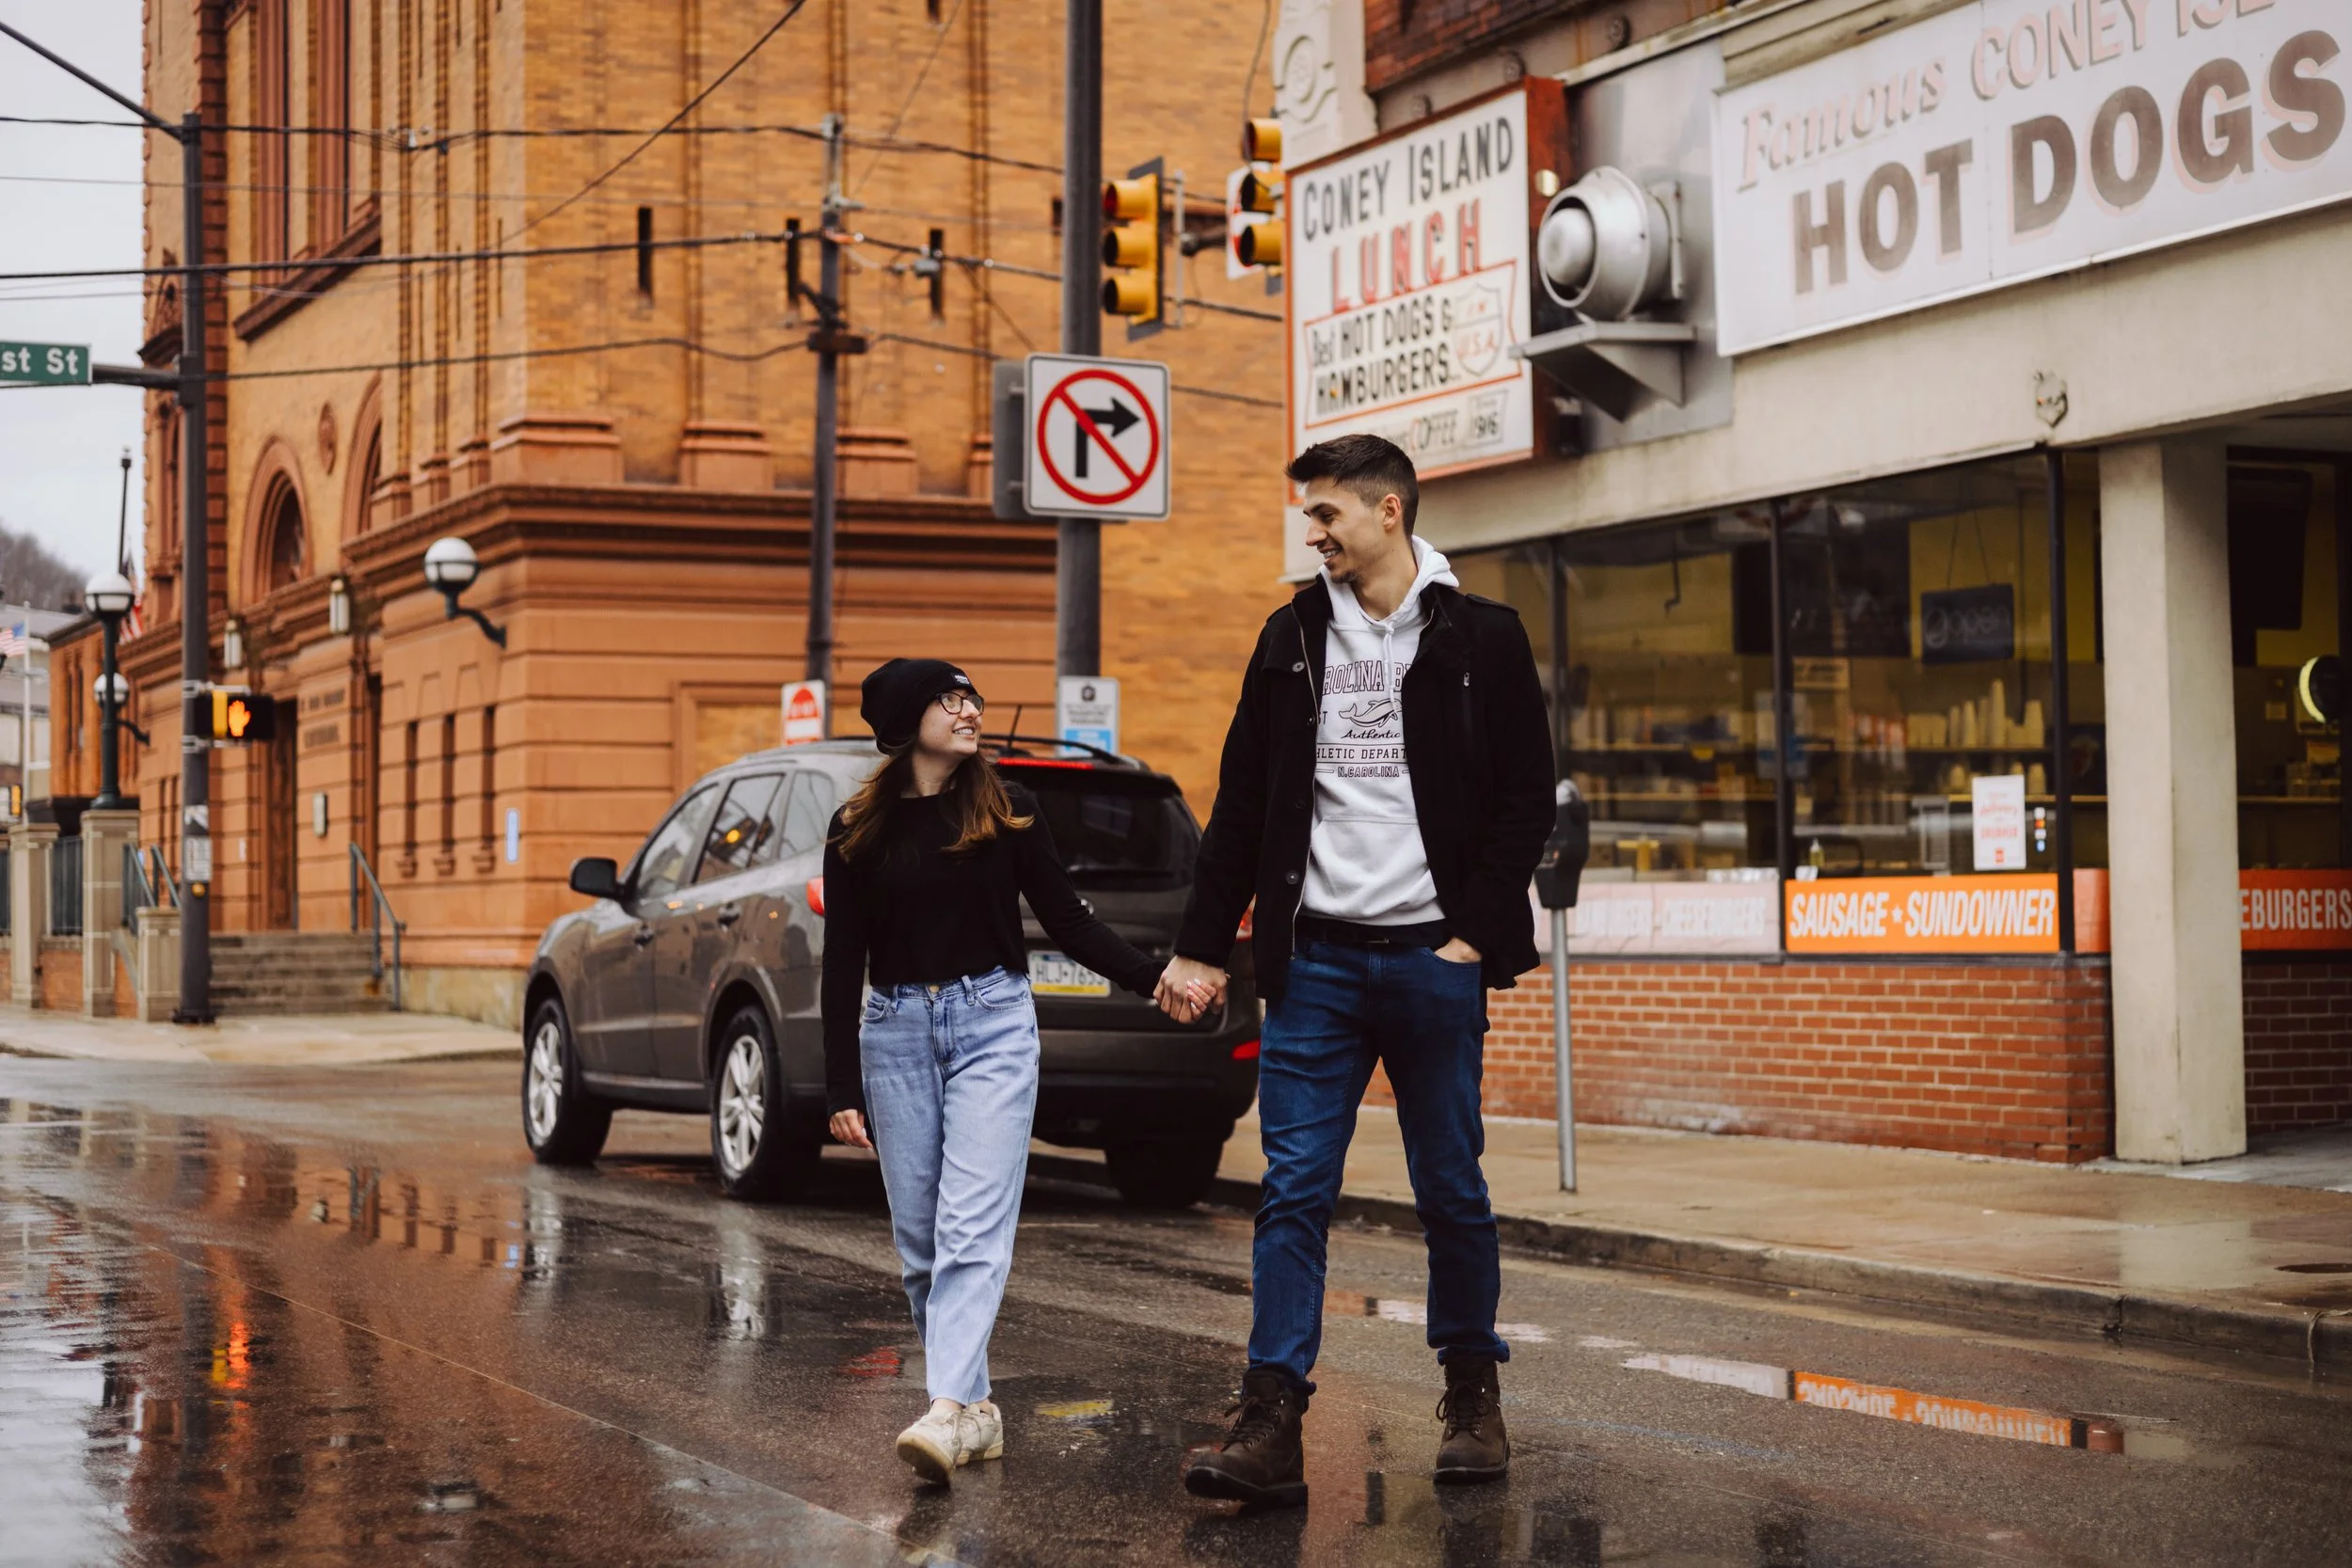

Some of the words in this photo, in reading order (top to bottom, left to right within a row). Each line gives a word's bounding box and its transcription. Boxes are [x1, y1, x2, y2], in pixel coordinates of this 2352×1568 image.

[1738, 56, 1947, 194] Famous
[1971, 0, 2149, 101] CONEY
[1303, 159, 1391, 243] CONEY
[1407, 117, 1514, 205] ISLAND
[1791, 137, 1974, 297] HOT
[2007, 29, 2346, 245] DOGS
[1330, 198, 1484, 312] LUNCH
[1341, 311, 1375, 359] HOT
[1384, 294, 1435, 346] DOGS
[2, 347, 31, 372] st
[47, 348, 79, 375] St
[1340, 728, 1401, 739] Authentic
[1337, 766, 1400, 778] N.CAROLINA
[1789, 892, 1890, 938] SAUSAGE
[1905, 889, 2056, 937] SUNDOWNER
